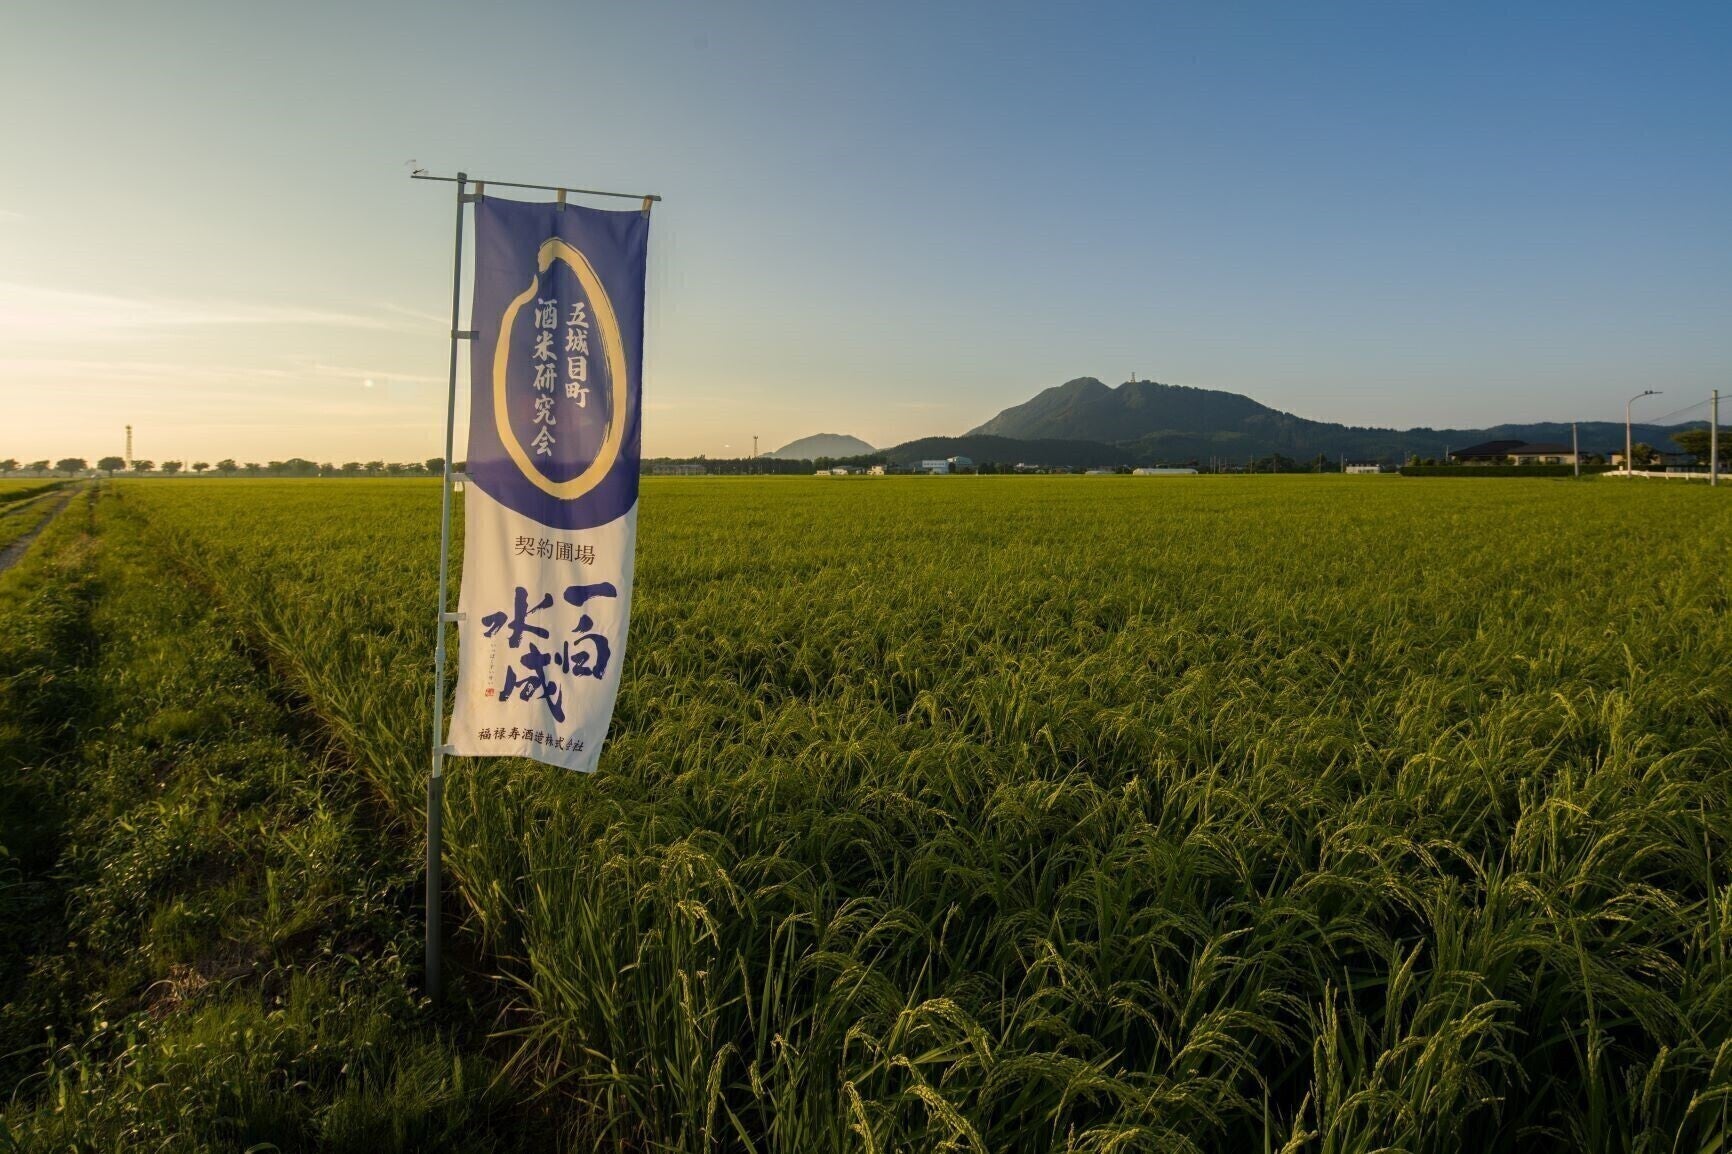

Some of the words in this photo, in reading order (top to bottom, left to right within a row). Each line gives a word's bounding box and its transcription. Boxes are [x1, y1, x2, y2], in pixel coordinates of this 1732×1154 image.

[531, 298, 557, 457] 酒米研究会
[565, 302, 590, 408] 五城目町
[514, 535, 596, 566] 契約圃場
[478, 726, 584, 752] 福禄寿酒造株式会社
